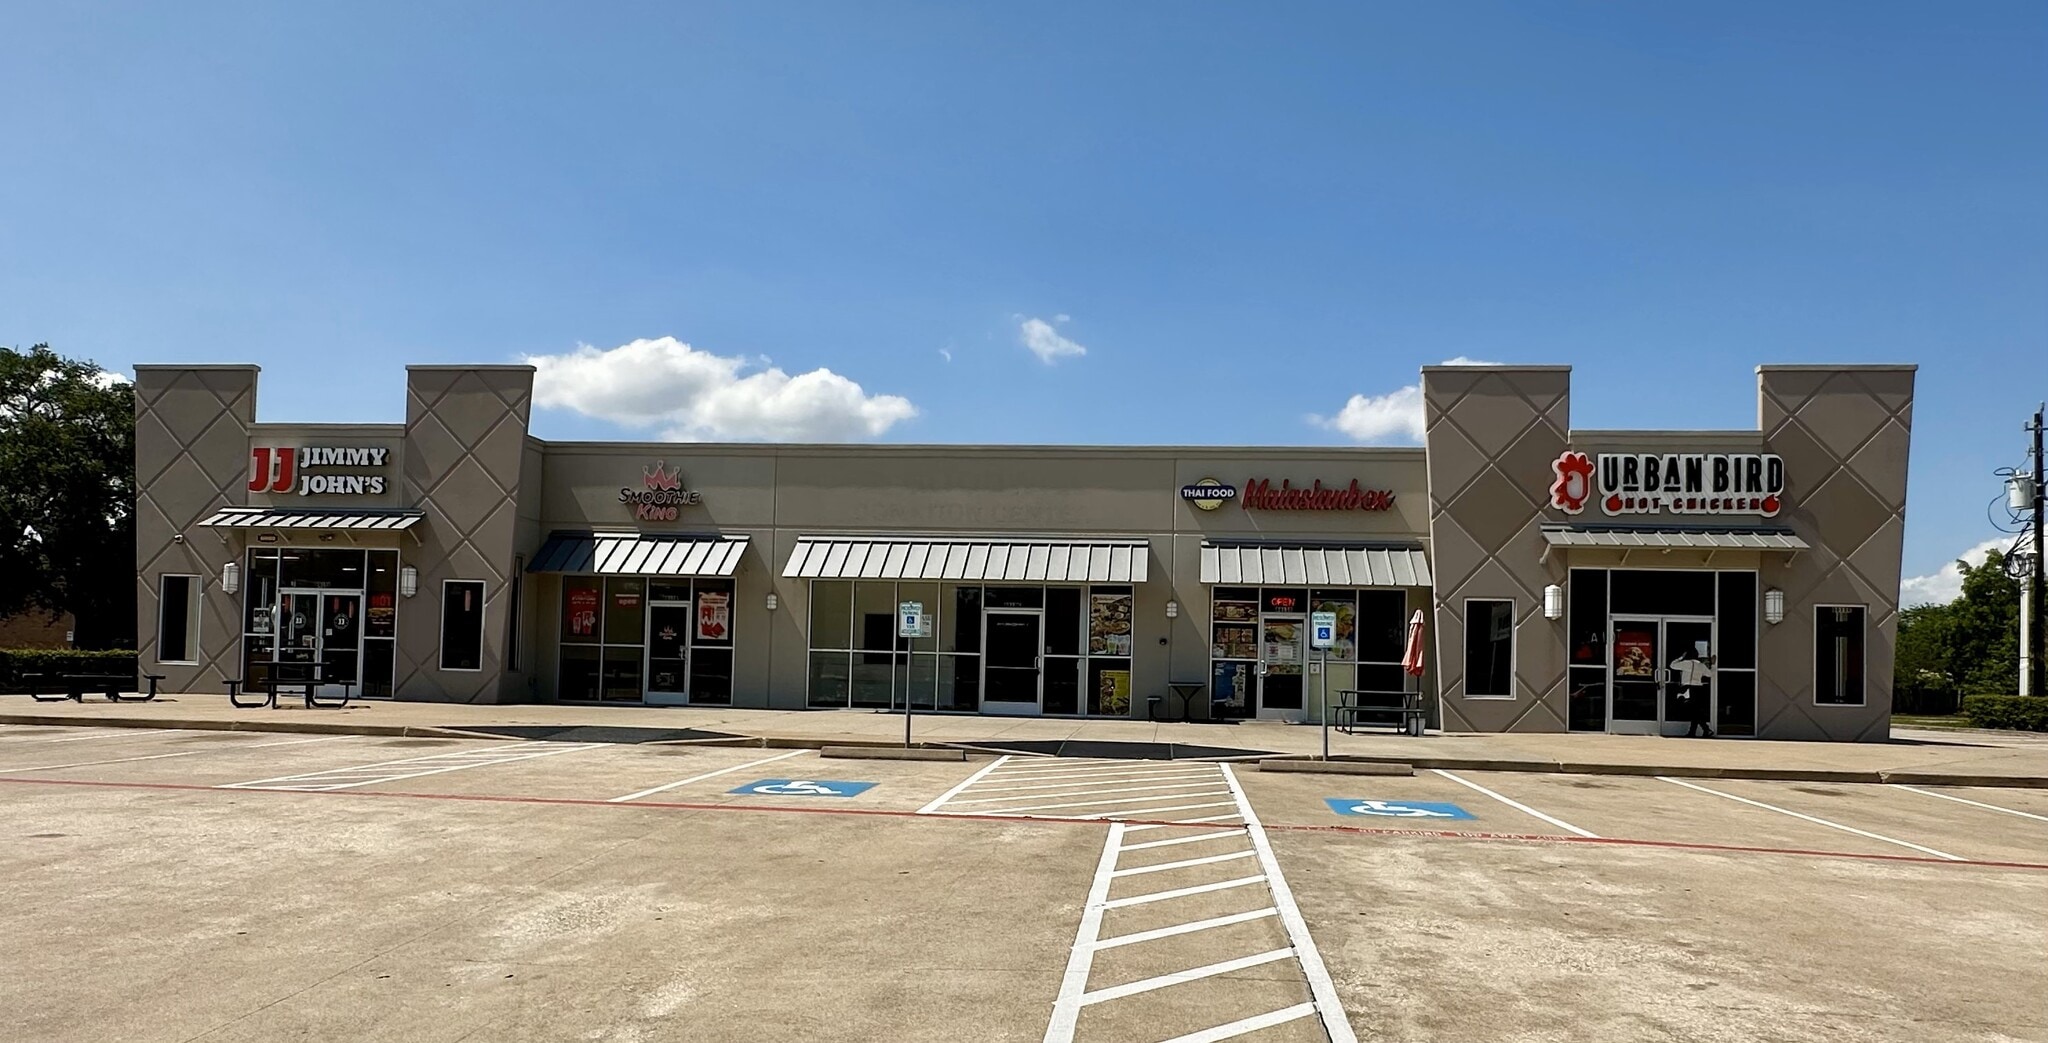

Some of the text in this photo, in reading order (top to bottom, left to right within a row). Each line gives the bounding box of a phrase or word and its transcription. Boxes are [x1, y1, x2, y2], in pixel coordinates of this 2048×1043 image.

[300, 447, 387, 468] JIMMY
[248, 447, 296, 494] JJ
[1603, 456, 1783, 493] URBAN BIRD
[299, 475, 384, 496] JOHN'S
[618, 487, 700, 505] SMOOTHIE
[1183, 488, 1235, 498] THAI FOOD
[1241, 478, 1394, 511] Maiasianbox
[1624, 497, 1760, 511] HOT CHICKEN
[1271, 597, 1296, 607] OPEN
